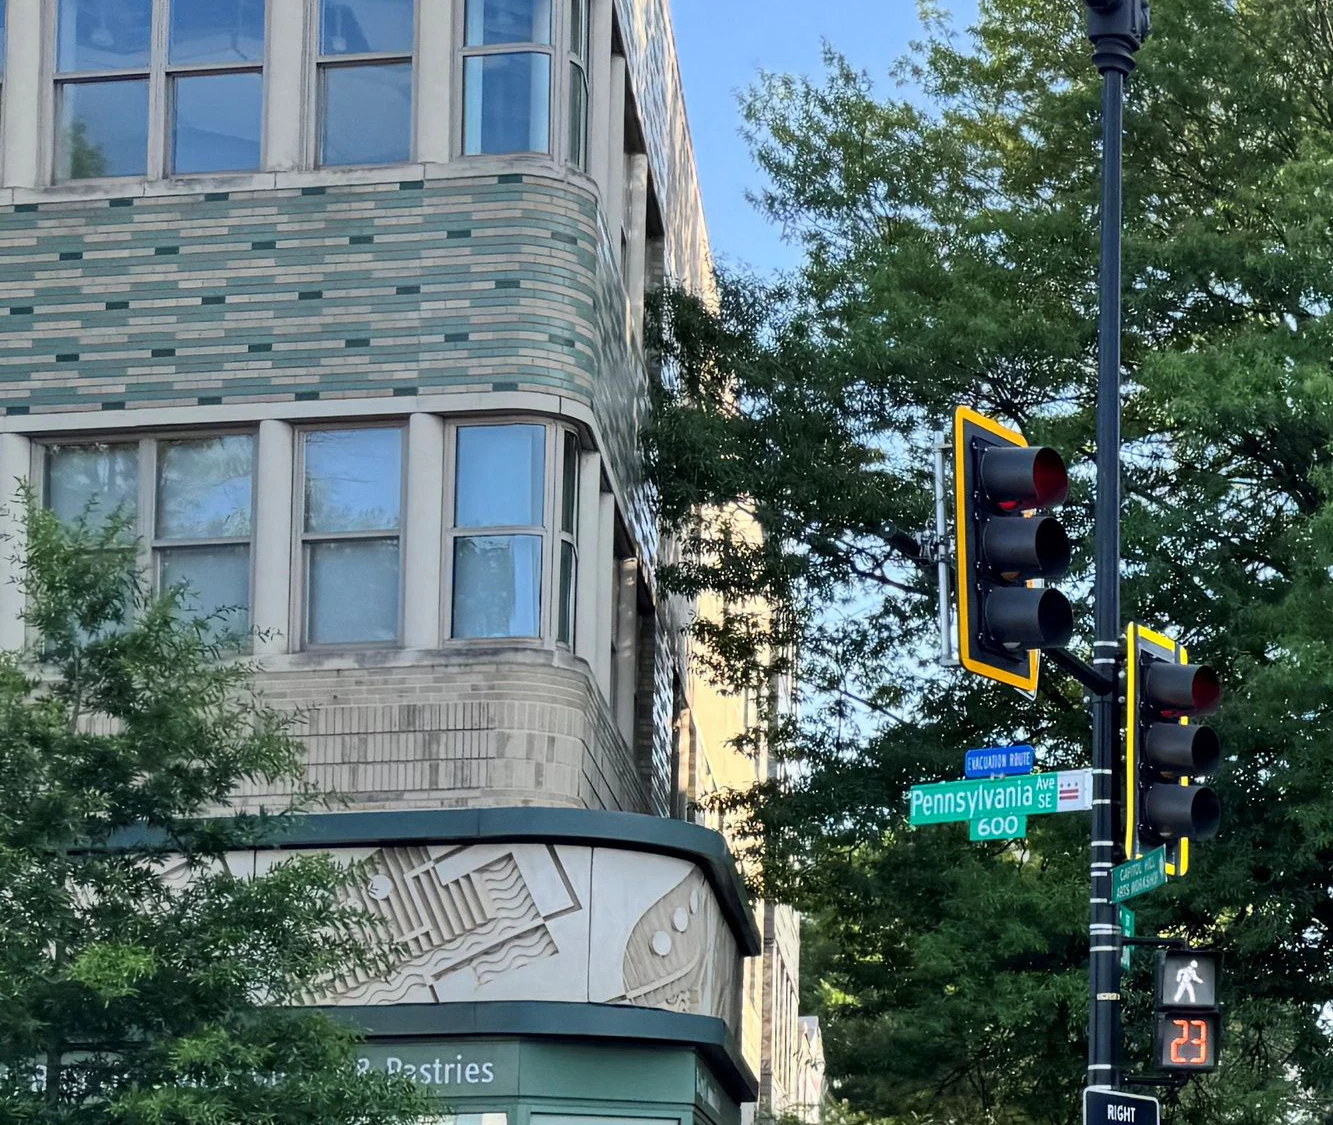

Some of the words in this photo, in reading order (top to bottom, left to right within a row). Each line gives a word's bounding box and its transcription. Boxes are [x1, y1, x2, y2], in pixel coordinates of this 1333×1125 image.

[967, 753, 1007, 771] EVACUATION
[1009, 751, 1031, 766] ROUTE
[912, 780, 1033, 818] Pennsylvania
[1036, 775, 1055, 790] Ave
[1038, 793, 1052, 808] SE
[977, 815, 1019, 836] 600
[1170, 1019, 1207, 1064] 23
[386, 1054, 494, 1085] Pastries
[1107, 1104, 1136, 1123] RIGHT
